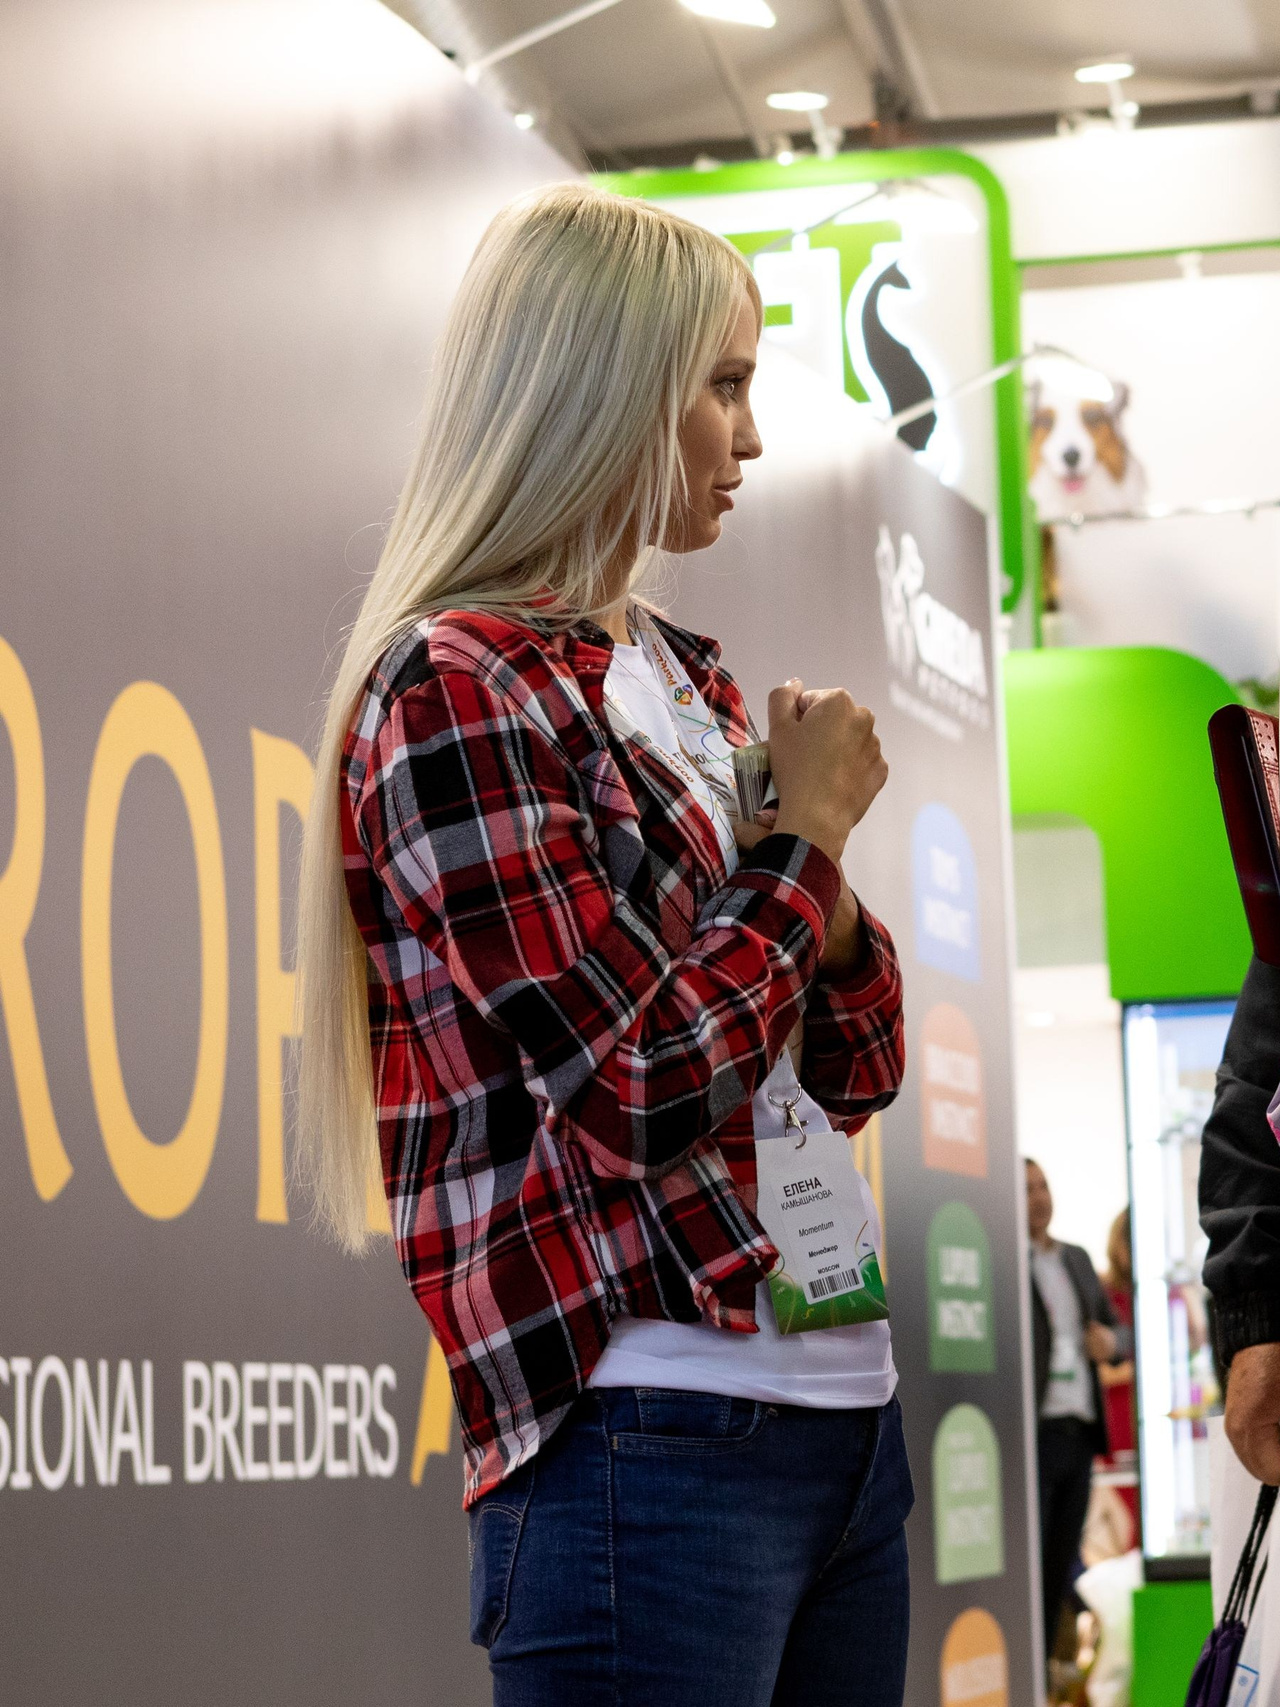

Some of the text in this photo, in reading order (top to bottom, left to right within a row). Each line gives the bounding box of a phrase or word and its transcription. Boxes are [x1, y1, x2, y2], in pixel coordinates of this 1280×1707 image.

[783, 1177, 823, 1198] ЕЛЕНА
[780, 1189, 834, 1211] КАМЫШАНОВА
[798, 1220, 835, 1238] Momentum
[808, 1244, 839, 1259] Менеджер
[817, 1263, 840, 1275] MOSCOW
[183, 1359, 400, 1484] BREEDERS
